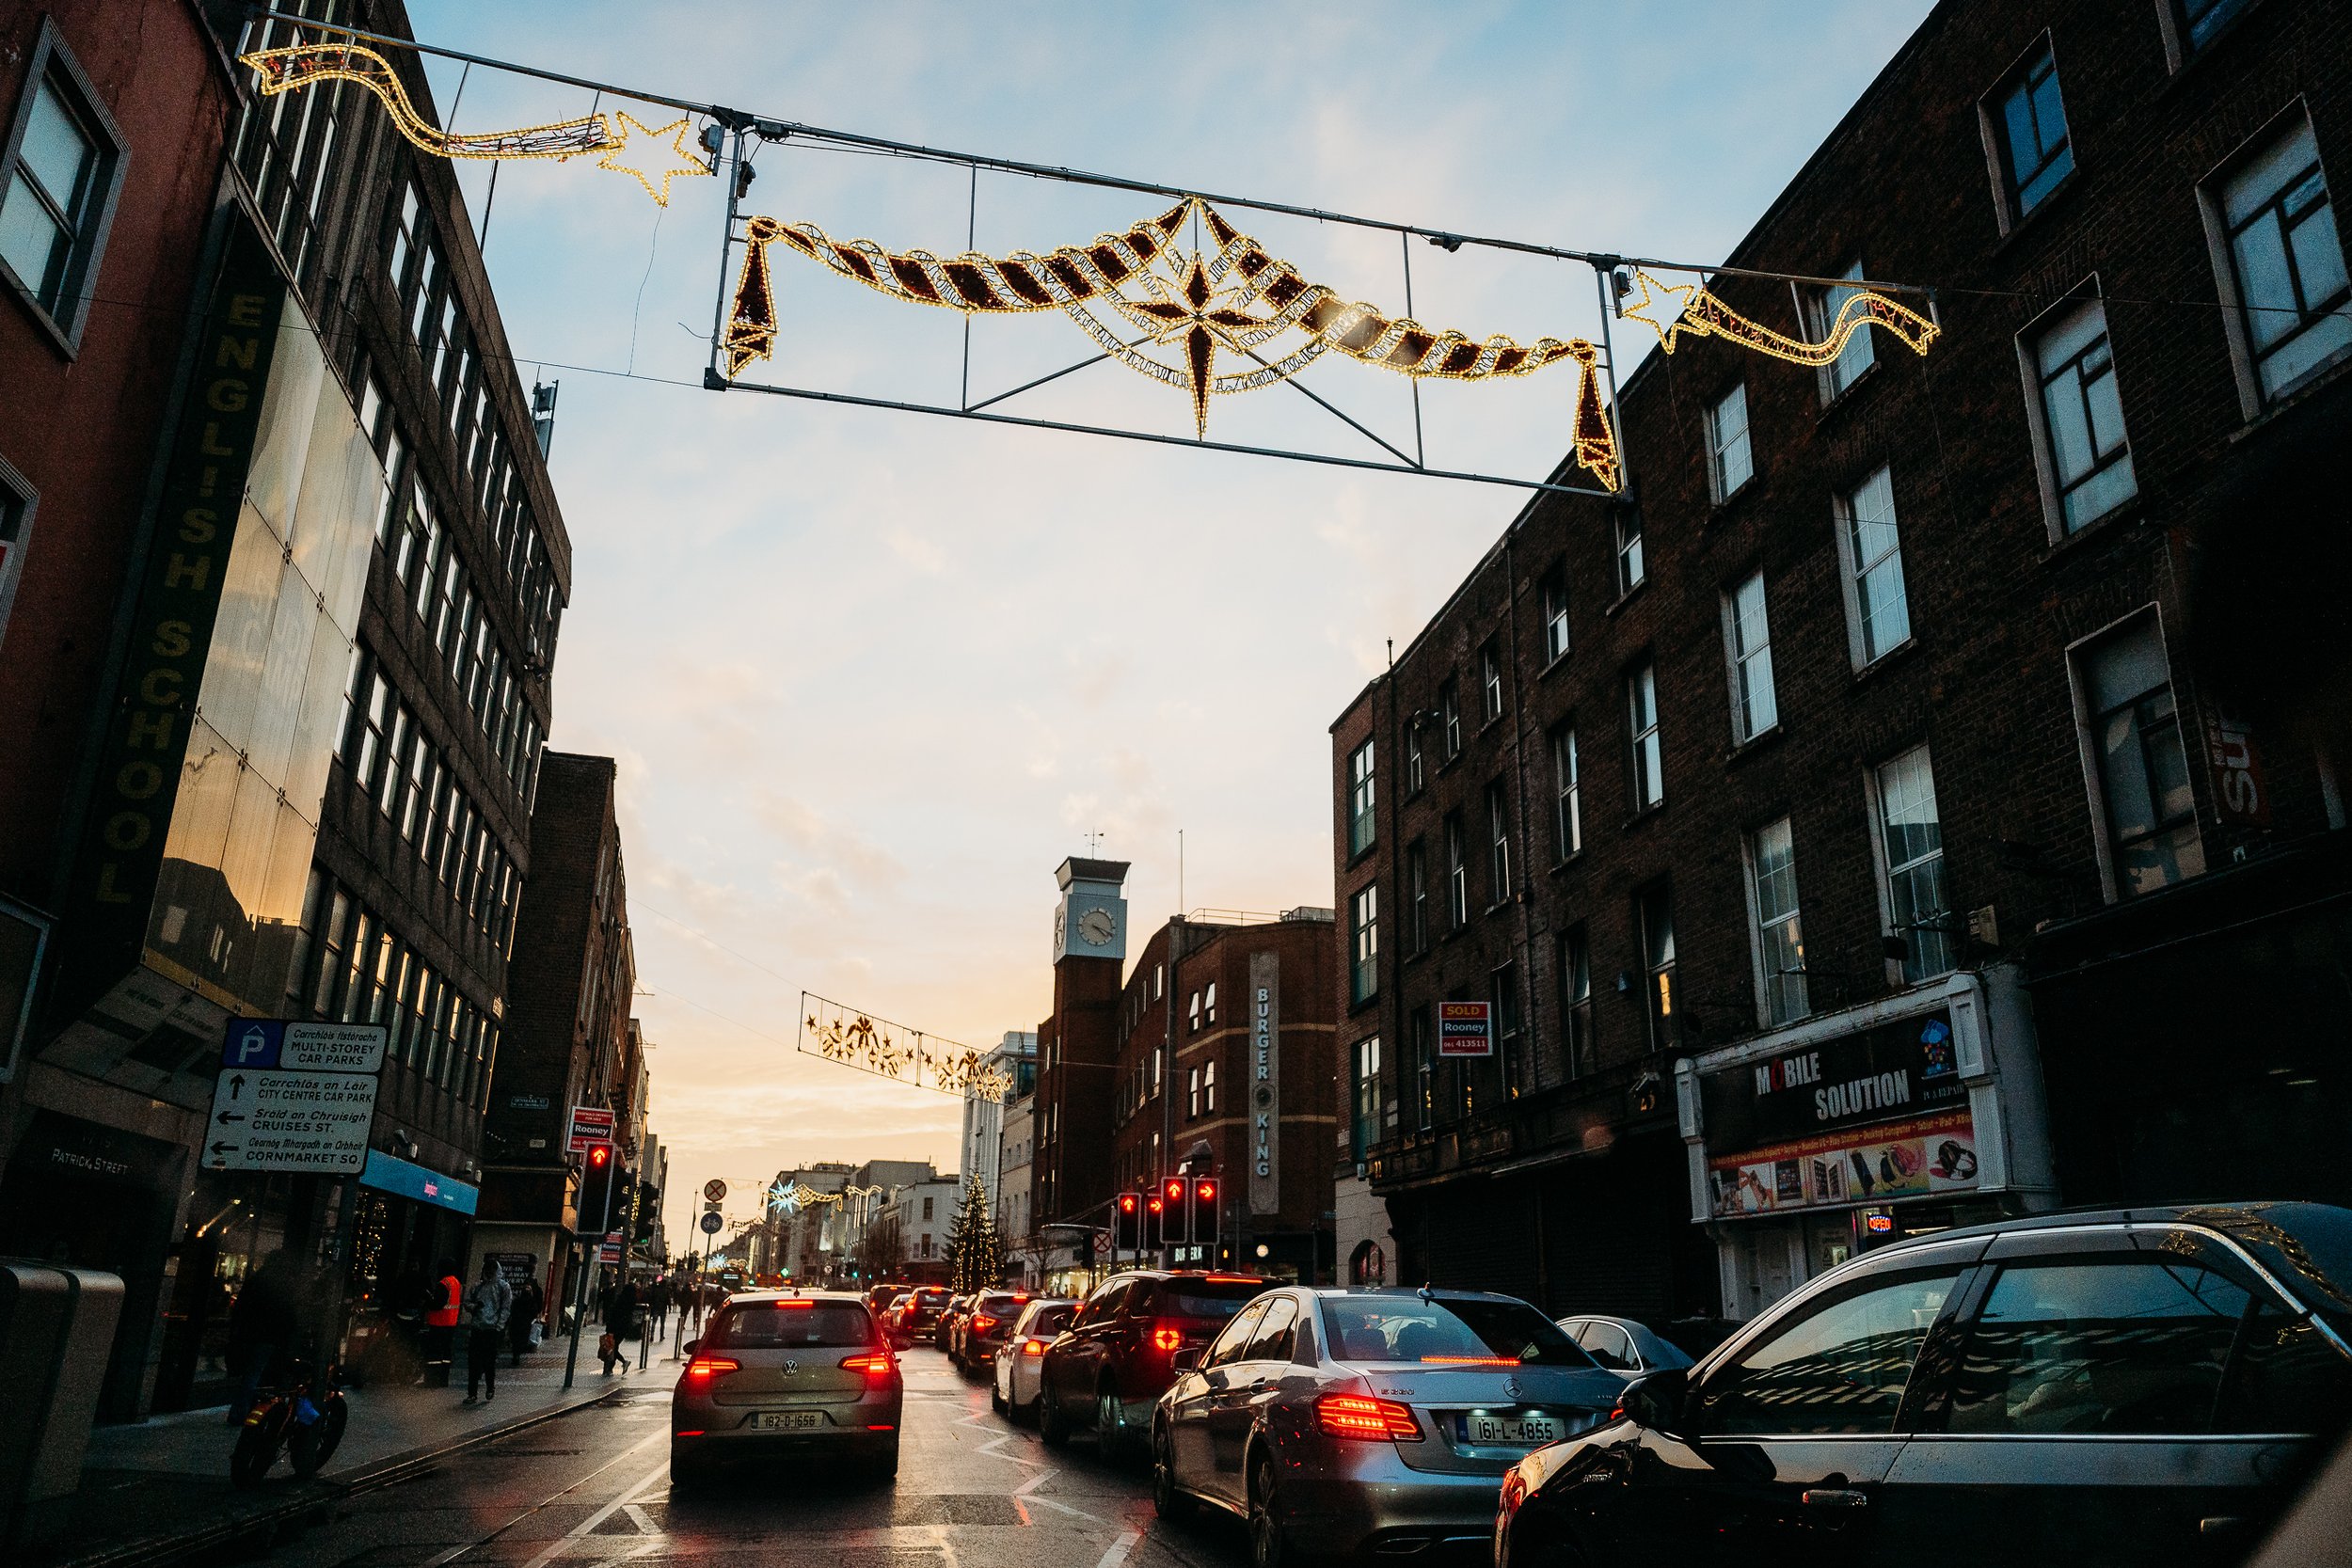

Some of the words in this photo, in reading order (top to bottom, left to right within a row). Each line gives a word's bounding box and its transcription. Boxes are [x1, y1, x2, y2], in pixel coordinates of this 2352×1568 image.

[164, 293, 266, 592] ENGLISH
[95, 619, 193, 904] SCHOOL
[1446, 1006, 1481, 1016] SOLD
[1257, 988, 1269, 1080] BURGER
[1444, 1022, 1486, 1034] Rooney
[291, 1041, 375, 1054] MULTI-STOREY
[1455, 1039, 1486, 1048] 413511
[298, 1053, 322, 1064] CAR
[326, 1054, 364, 1066] PARKS
[1755, 1052, 1821, 1097] MOBILE
[325, 1082, 340, 1090] an
[258, 1089, 279, 1099] CITY
[282, 1090, 321, 1101] CENTRE
[324, 1092, 343, 1102] CAR
[346, 1093, 373, 1103] PARK
[1815, 1069, 1912, 1121] SOLUTION
[291, 1112, 306, 1120] an
[252, 1120, 310, 1132] CRUISES
[315, 1123, 334, 1133] ST.
[575, 1124, 609, 1136] Rooney
[323, 1141, 333, 1149] an
[1256, 1113, 1269, 1177] KING
[51, 1148, 92, 1170] PATRICK
[93, 1157, 129, 1175] STREET
[246, 1150, 337, 1164] CORNMARKET
[1868, 1218, 1892, 1230] OPEN
[1478, 1421, 1553, 1440] 161-L-4855
